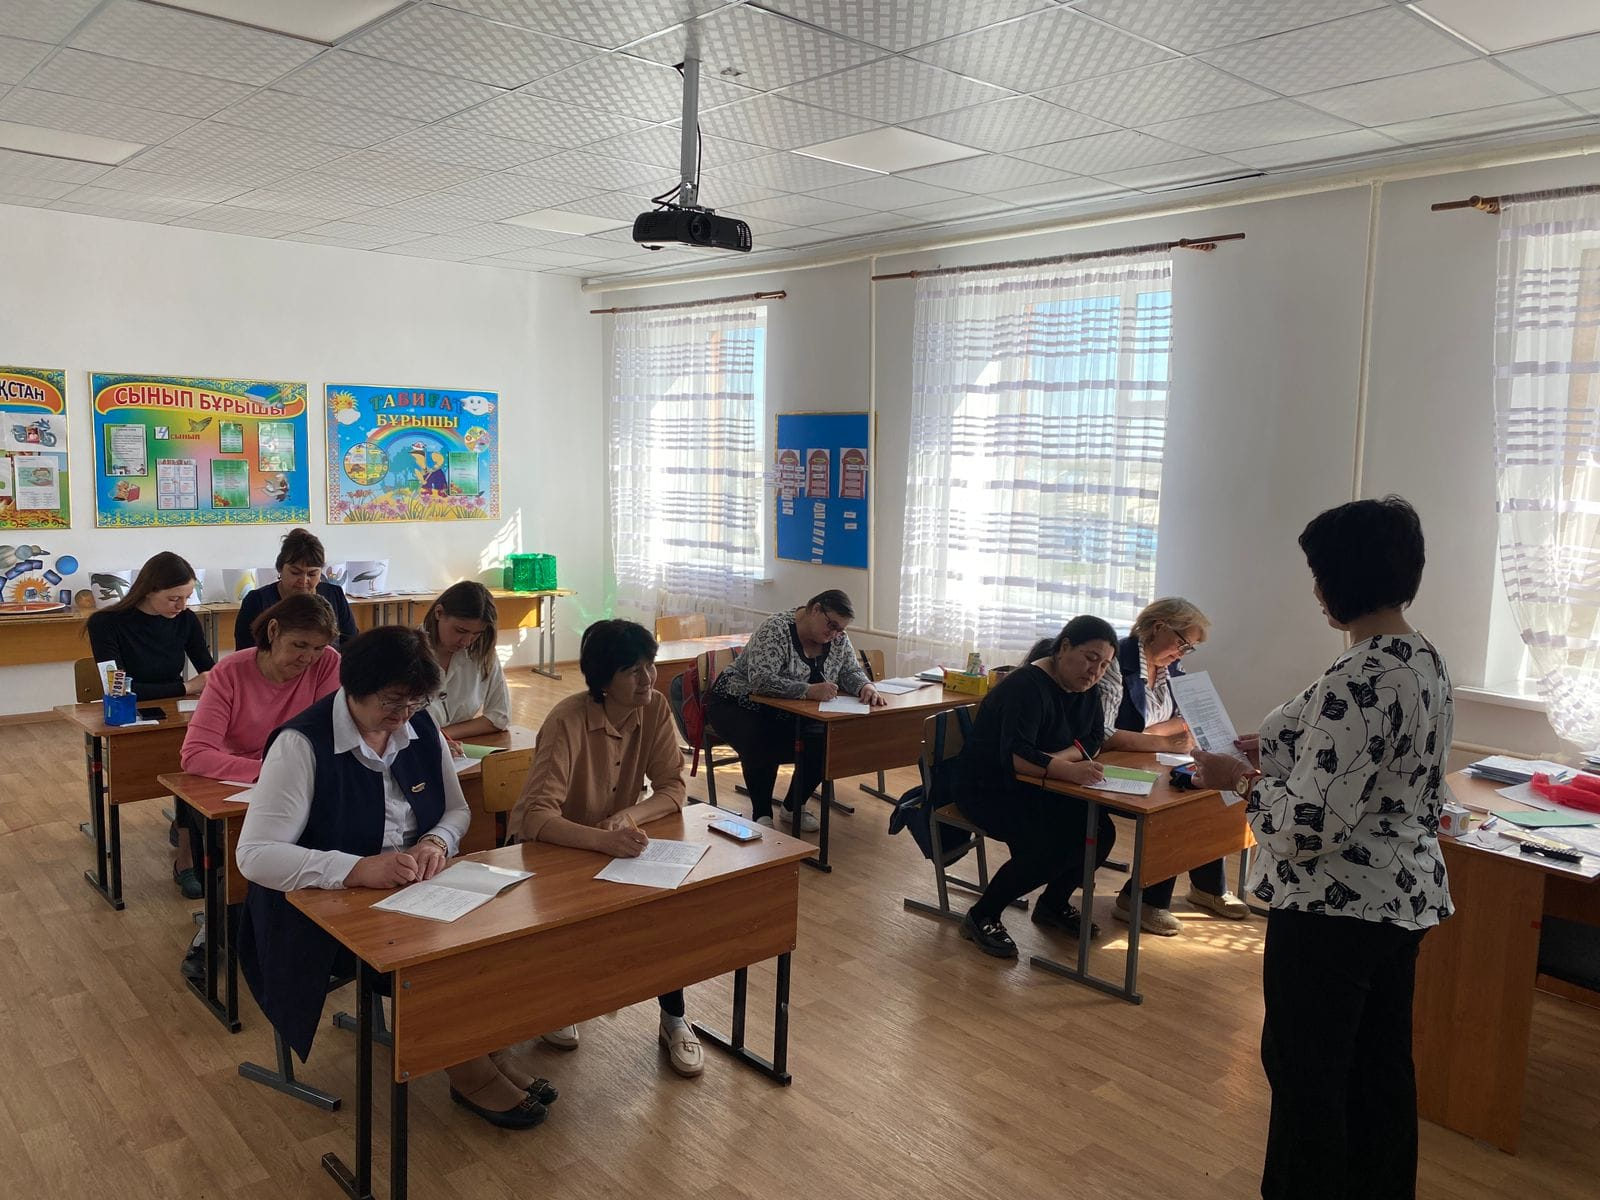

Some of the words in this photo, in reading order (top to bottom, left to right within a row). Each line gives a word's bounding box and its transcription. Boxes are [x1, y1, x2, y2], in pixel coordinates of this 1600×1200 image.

[115, 386, 193, 408] СЫНЫП
[199, 393, 286, 415] БҰРЫШЫ
[369, 392, 463, 414] ТАБИҒАТ
[376, 414, 458, 428] БҰРЫШЫ
